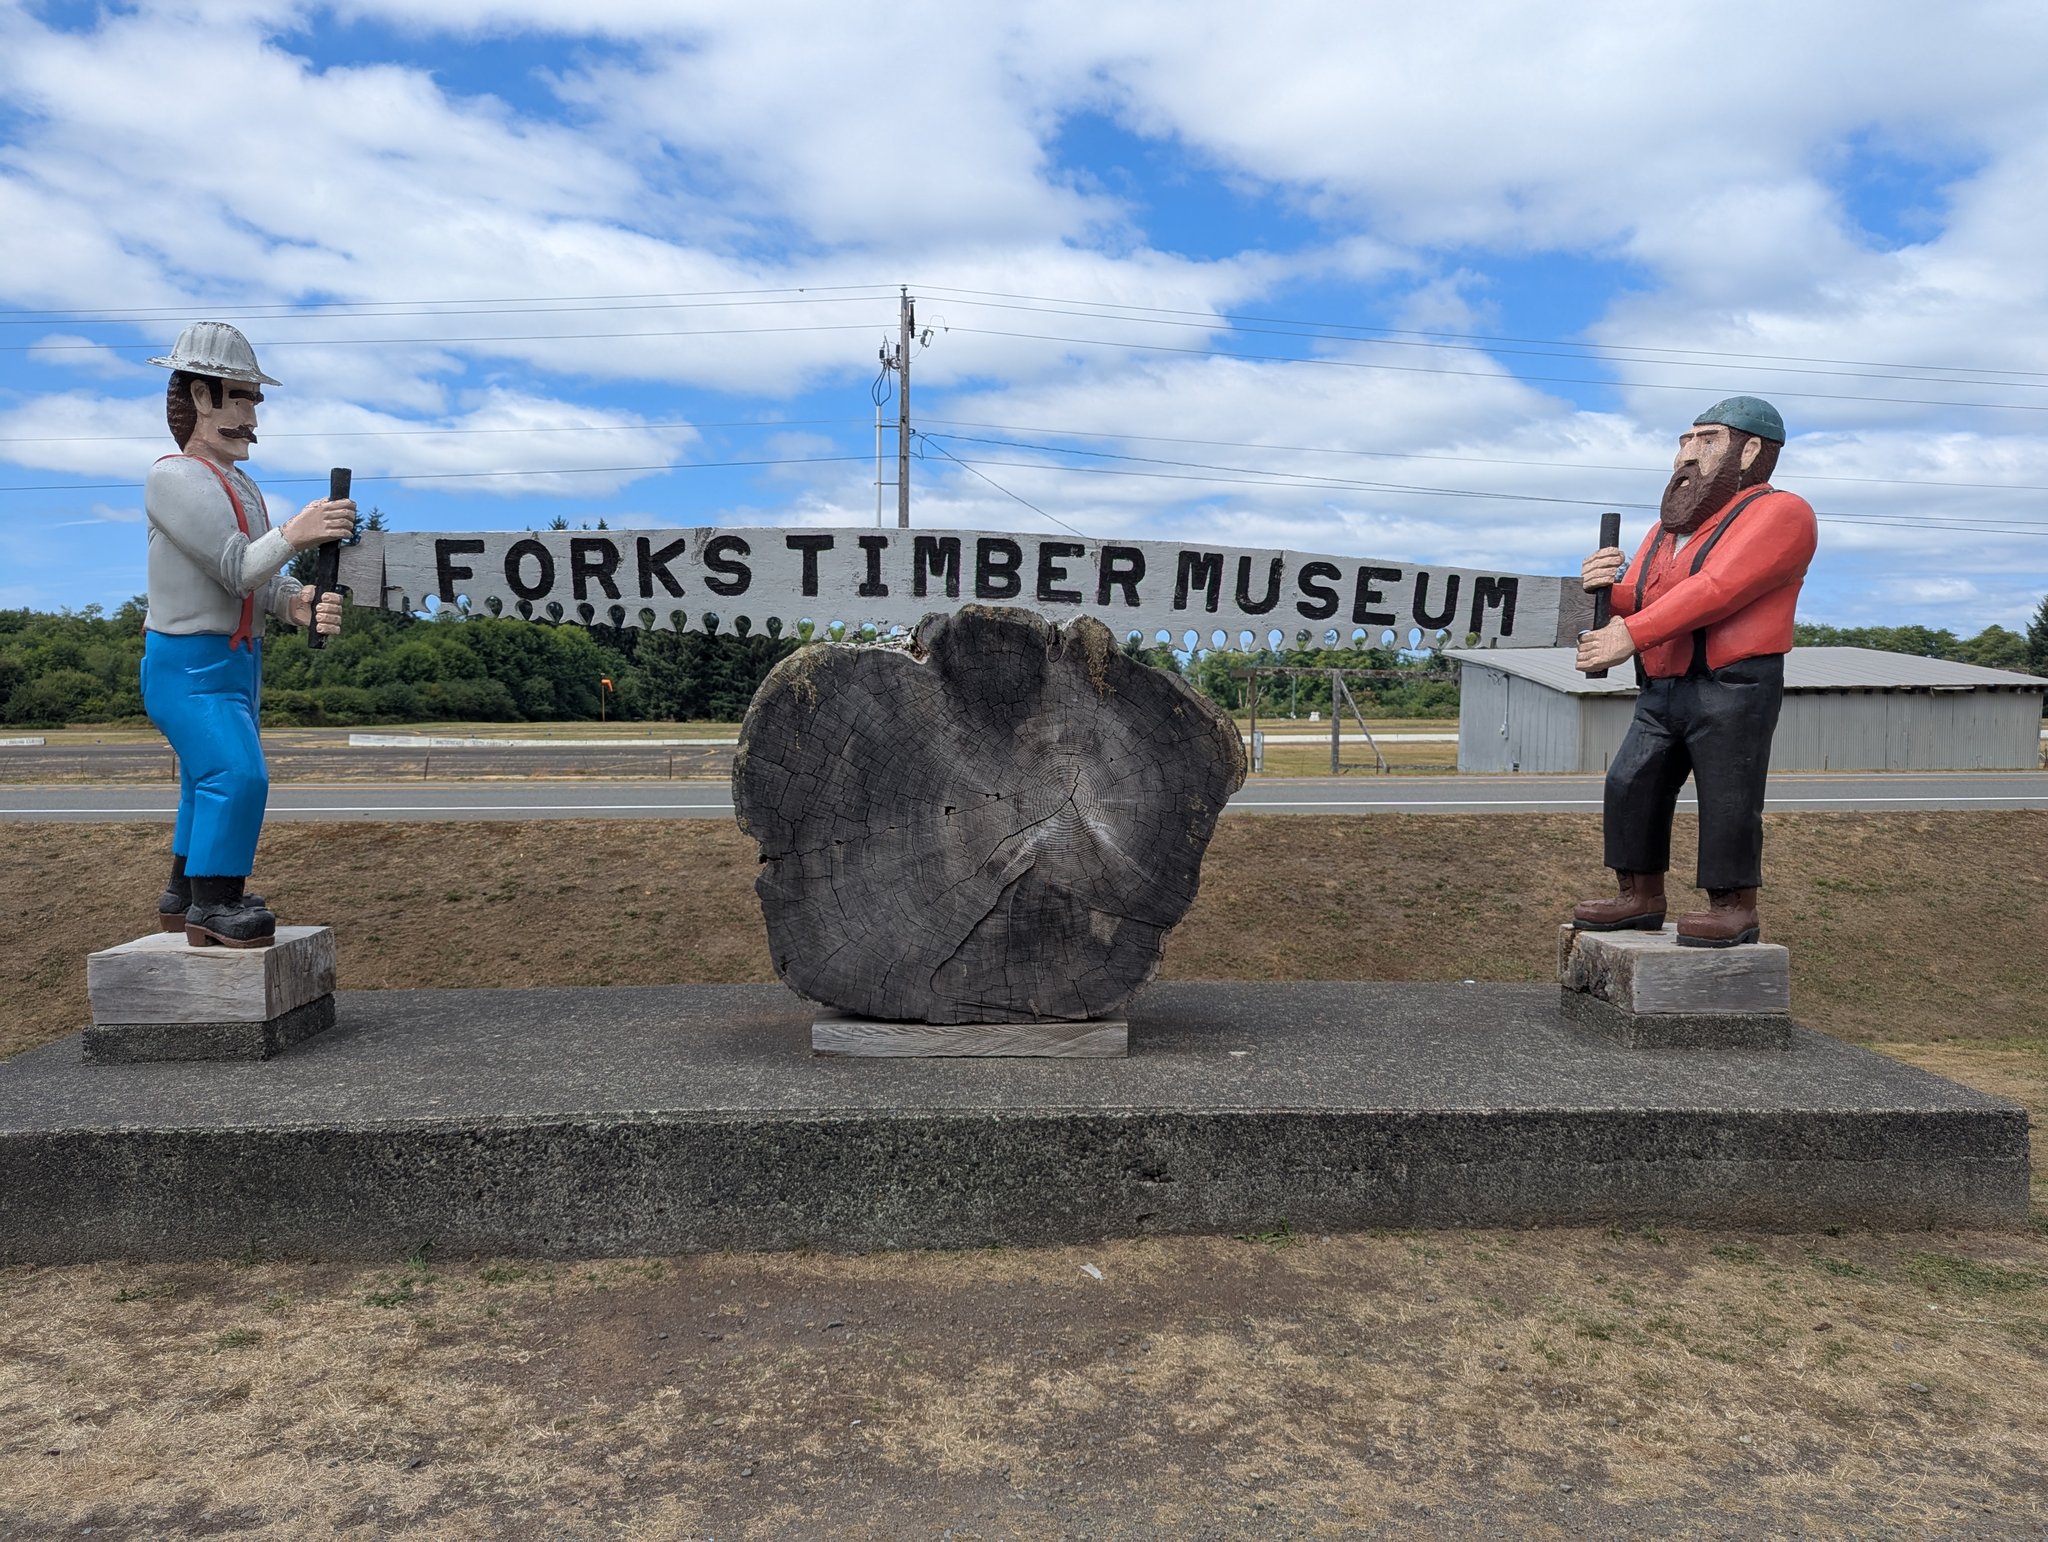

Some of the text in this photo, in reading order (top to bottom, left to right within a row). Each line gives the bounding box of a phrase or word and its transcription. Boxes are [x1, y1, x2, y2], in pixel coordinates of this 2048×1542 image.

[435, 535, 1519, 637] FORKS TIMBER MUSEUM
